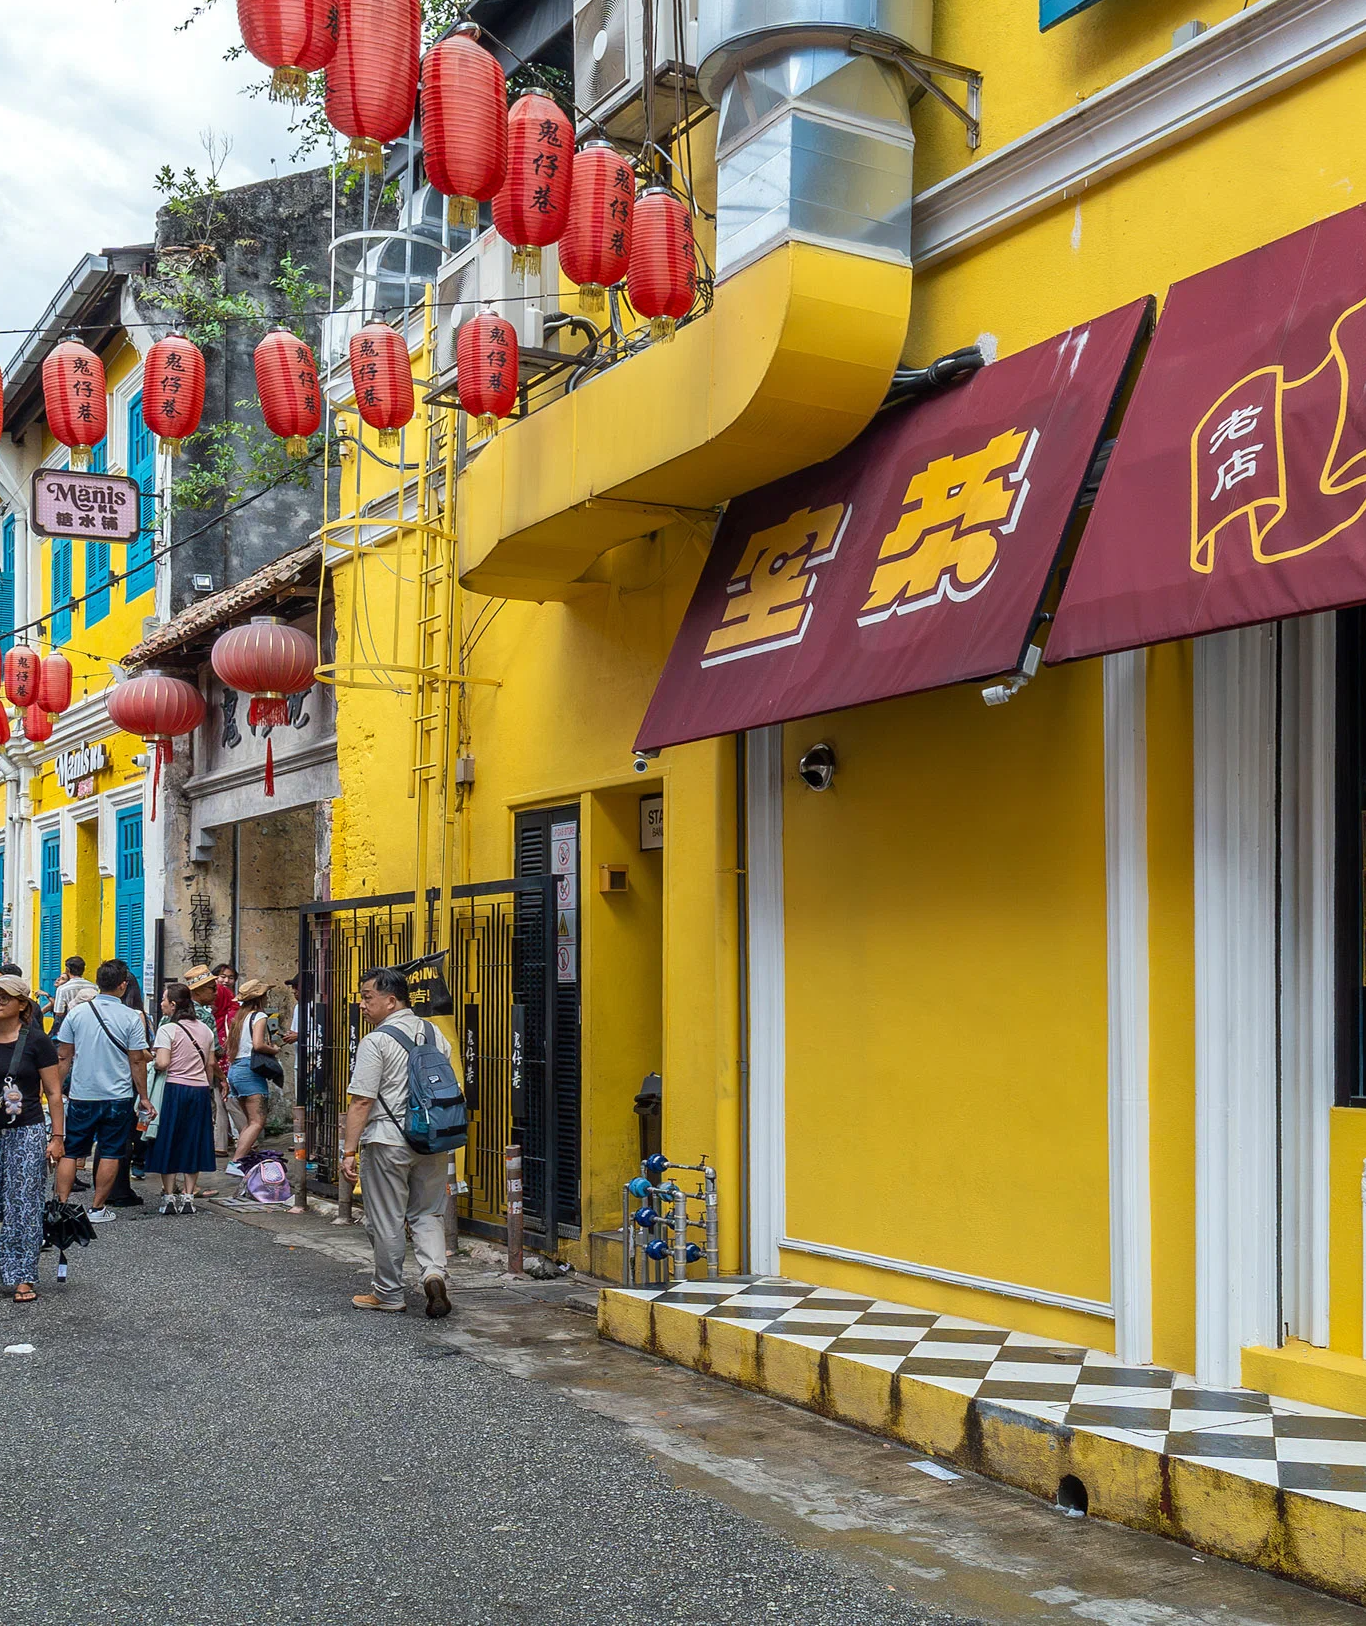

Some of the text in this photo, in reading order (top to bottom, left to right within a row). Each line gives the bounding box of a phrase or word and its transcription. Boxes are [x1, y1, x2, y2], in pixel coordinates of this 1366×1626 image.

[529, 118, 563, 214] 鬼仔巷
[609, 165, 632, 258] 鬼仔巷
[72, 356, 99, 423] 鬼仔巷
[158, 352, 185, 419] 鬼仔巷
[295, 346, 319, 415] 鬼仔巷
[359, 338, 384, 407] 鬼仔巷
[487, 325, 510, 394] 鬼仔巷
[1208, 404, 1265, 501] 老店
[46, 482, 127, 512] Manis
[98, 504, 119, 514] KL
[16, 656, 31, 698] 鬼仔巷
[55, 740, 90, 798] Manis
[188, 892, 214, 967] 鬼仔巷
